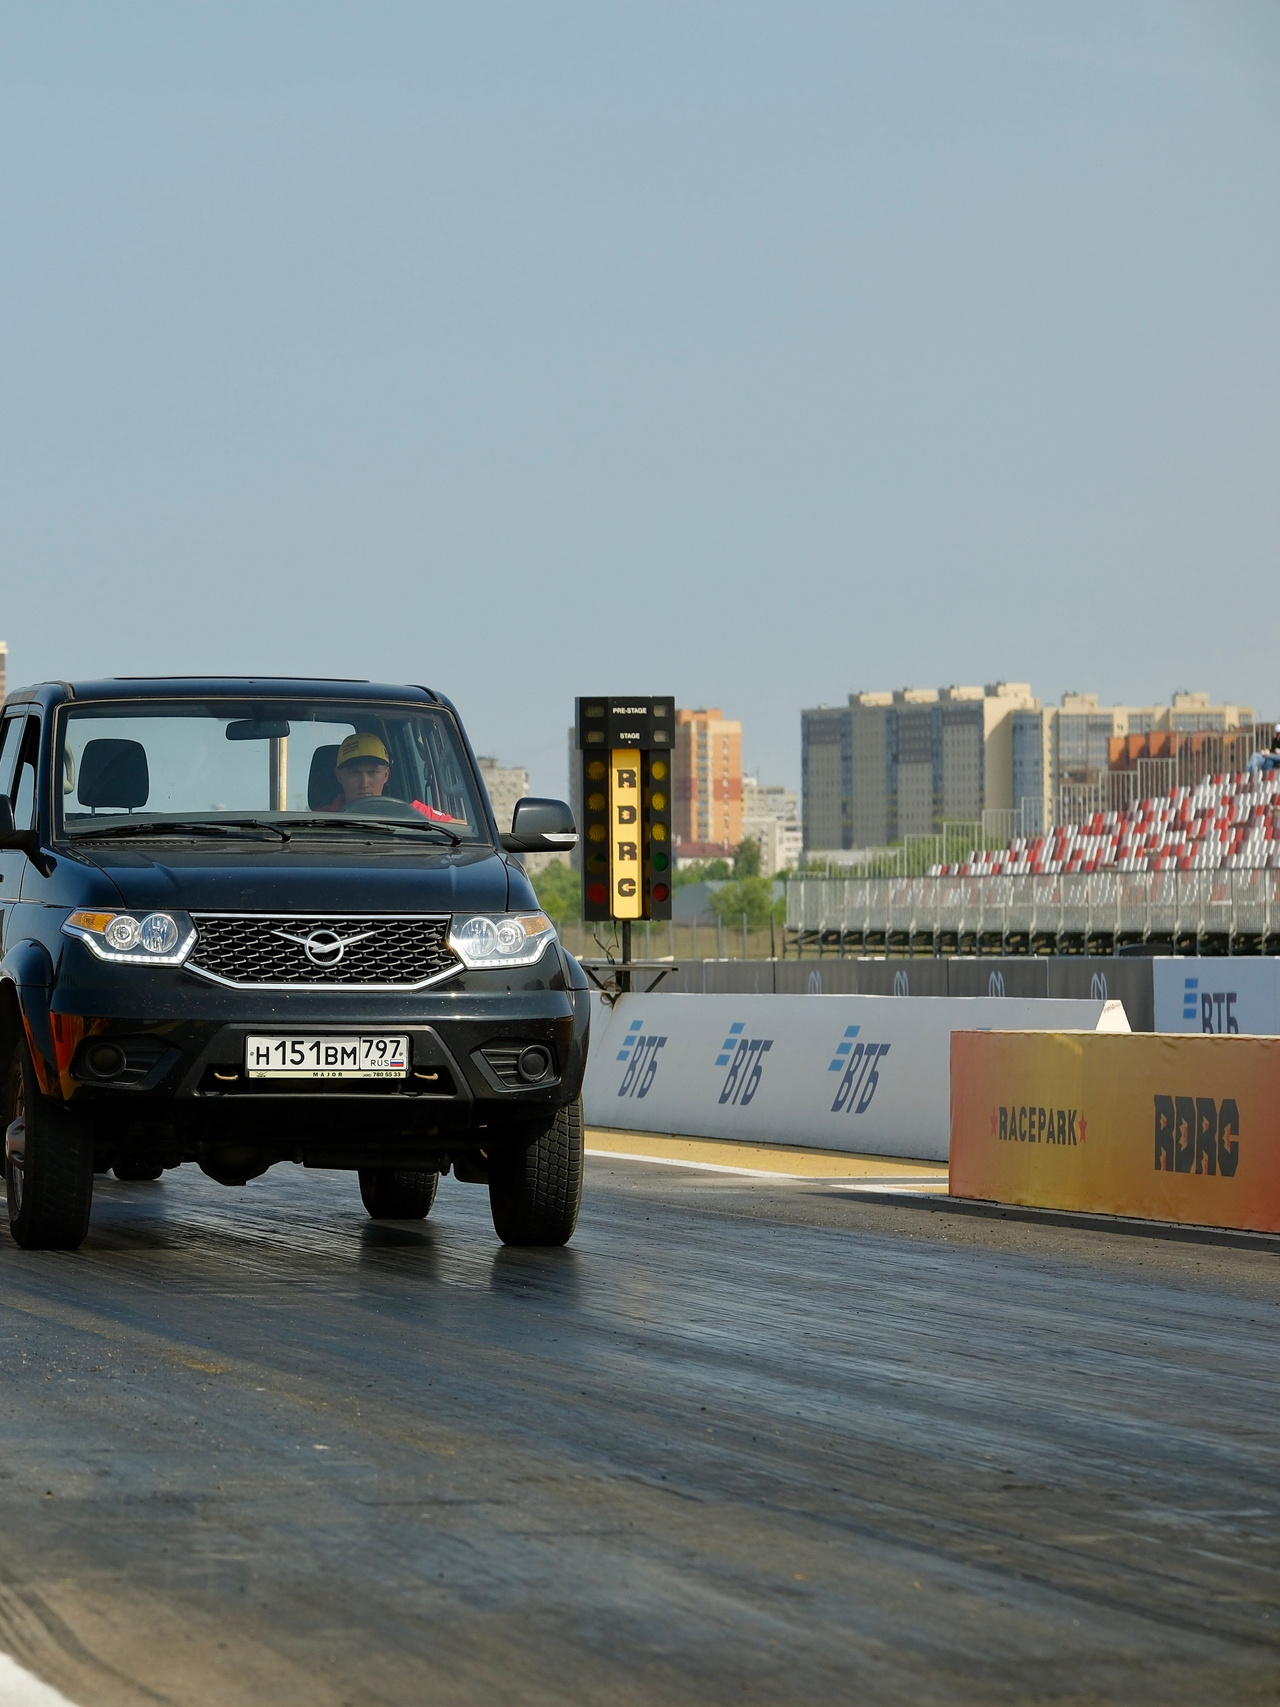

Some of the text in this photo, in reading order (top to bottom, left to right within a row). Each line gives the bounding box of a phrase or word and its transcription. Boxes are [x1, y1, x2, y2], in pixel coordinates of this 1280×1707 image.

[612, 706, 647, 714] PRE-STAGE
[619, 732, 640, 740] STAGE
[362, 1039, 401, 1059] 797
[370, 1059, 390, 1067] RUS
[617, 1036, 668, 1098] ВТБ
[718, 1039, 774, 1106] ВТБ
[830, 1043, 891, 1114] ВТБ
[998, 1106, 1078, 1146] RACEPARK
